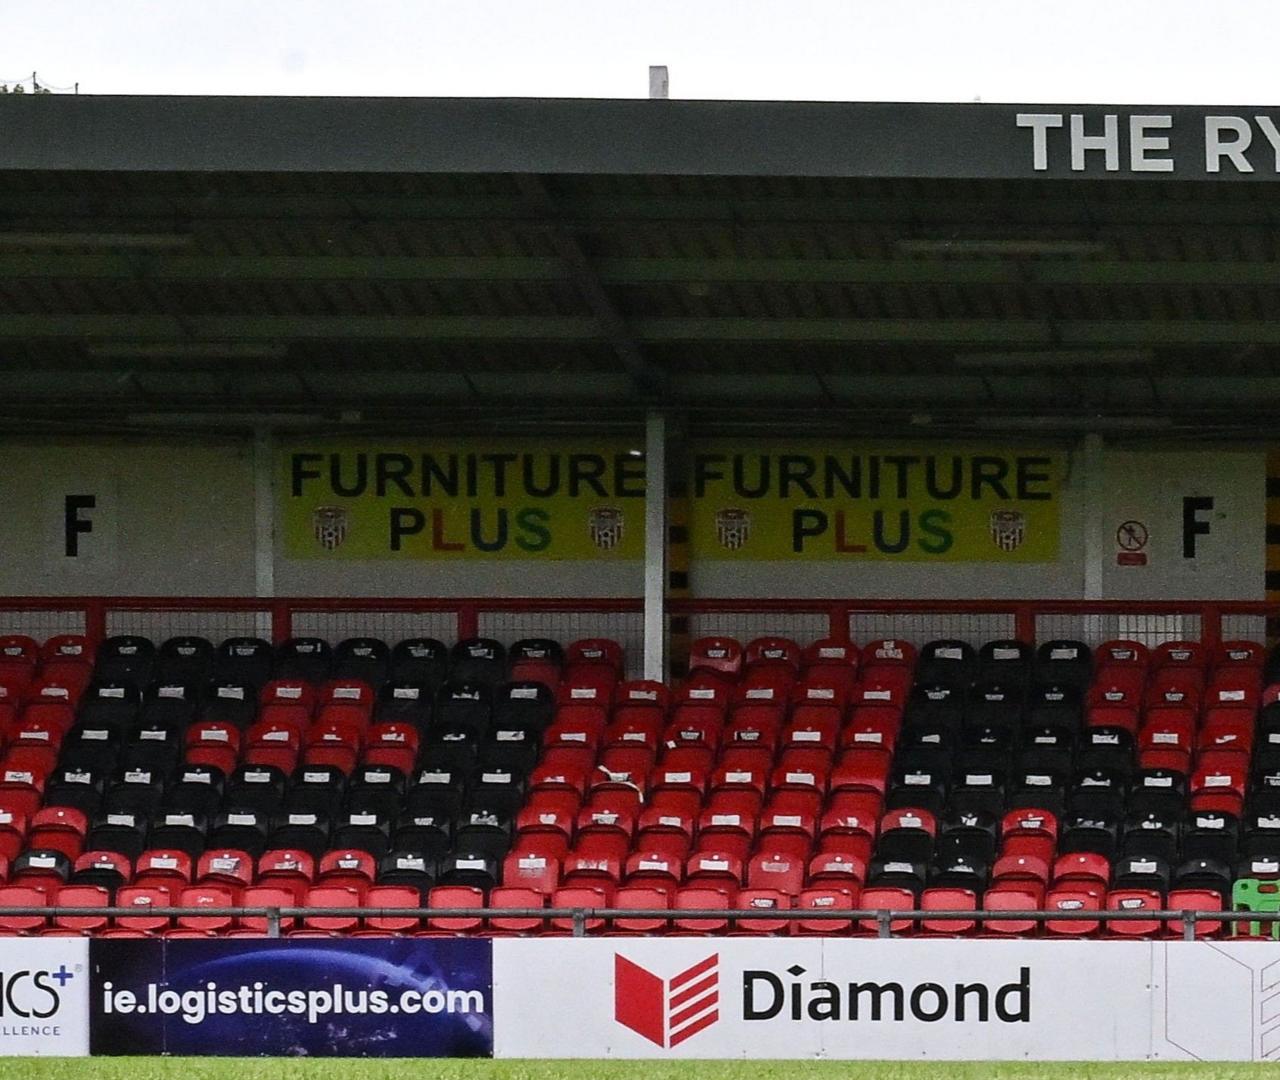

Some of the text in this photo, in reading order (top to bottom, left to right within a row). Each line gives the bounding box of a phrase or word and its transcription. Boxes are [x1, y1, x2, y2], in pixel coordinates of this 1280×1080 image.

[1016, 113, 1175, 173] THE
[291, 453, 646, 498] FURNITURE
[694, 454, 1052, 501] FURNITURE
[65, 494, 96, 557] F
[390, 506, 552, 552] PLUS
[792, 508, 954, 554] PLUS
[1183, 496, 1215, 558] F
[103, 981, 484, 1025] ie.logisticsplus.com
[742, 964, 1031, 1023] Diamond
